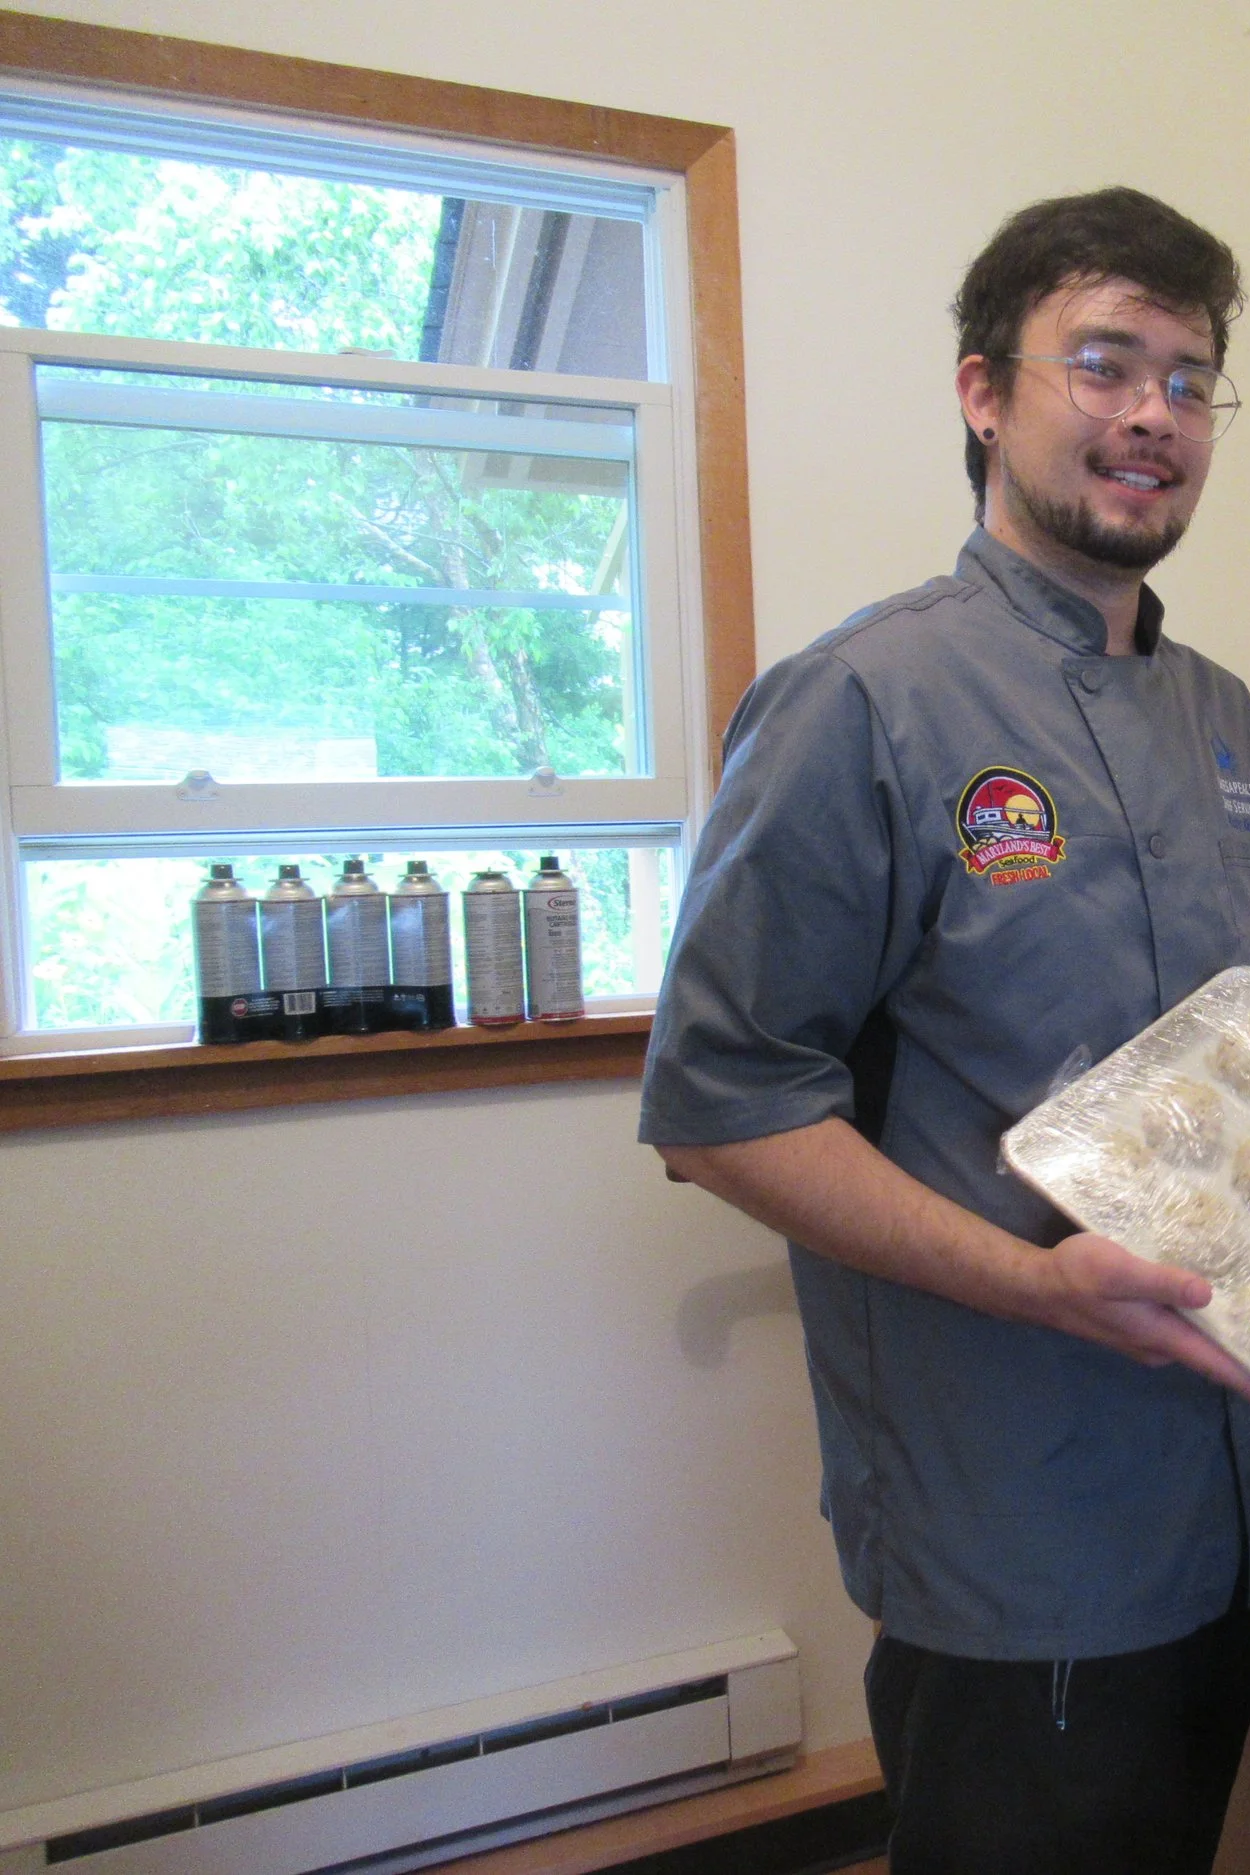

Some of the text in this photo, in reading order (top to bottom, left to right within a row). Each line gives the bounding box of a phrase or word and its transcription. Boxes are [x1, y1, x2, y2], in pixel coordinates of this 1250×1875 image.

[976, 840, 1051, 865] MARYLAND'S BEST
[998, 856, 1035, 868] Seafood
